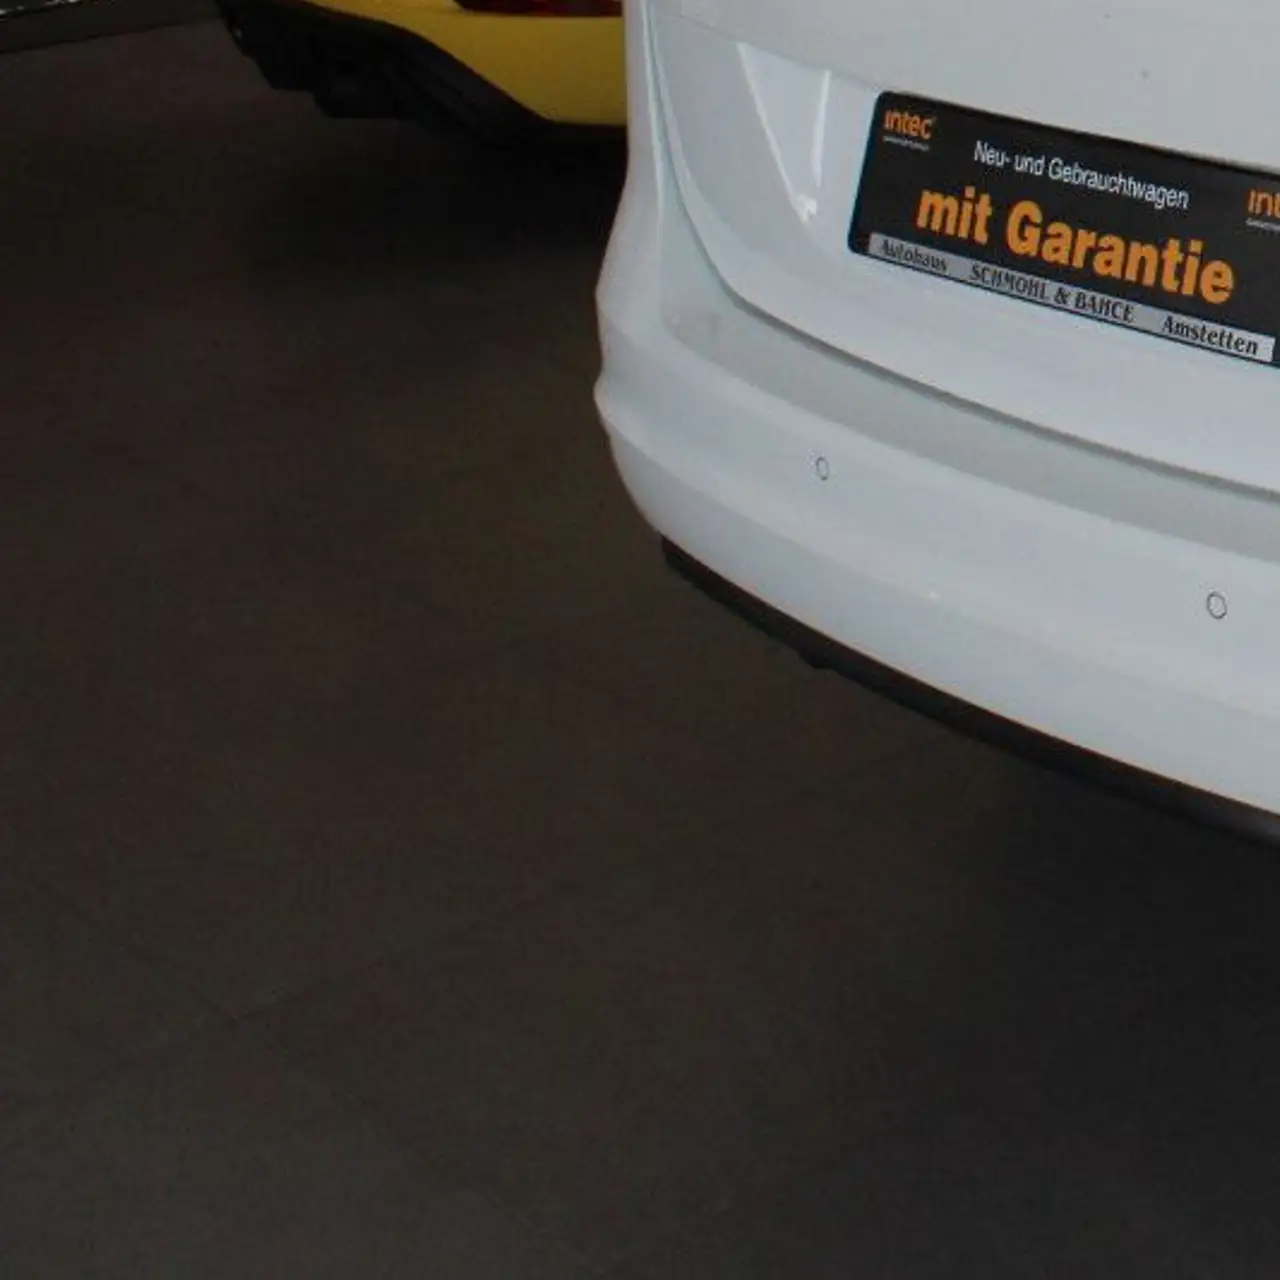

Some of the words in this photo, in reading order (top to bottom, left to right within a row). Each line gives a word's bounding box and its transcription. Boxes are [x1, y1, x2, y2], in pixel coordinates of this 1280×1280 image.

[974, 140, 1011, 168] Neu-
[1014, 154, 1045, 176] und
[1049, 157, 1190, 210] Gebrauchtwagen
[881, 238, 948, 273] Autohaus
[1054, 287, 1071, 306] &
[1161, 316, 1259, 357] Amstetten
[916, 186, 991, 245] mit
[1006, 200, 1235, 304] Garantie
